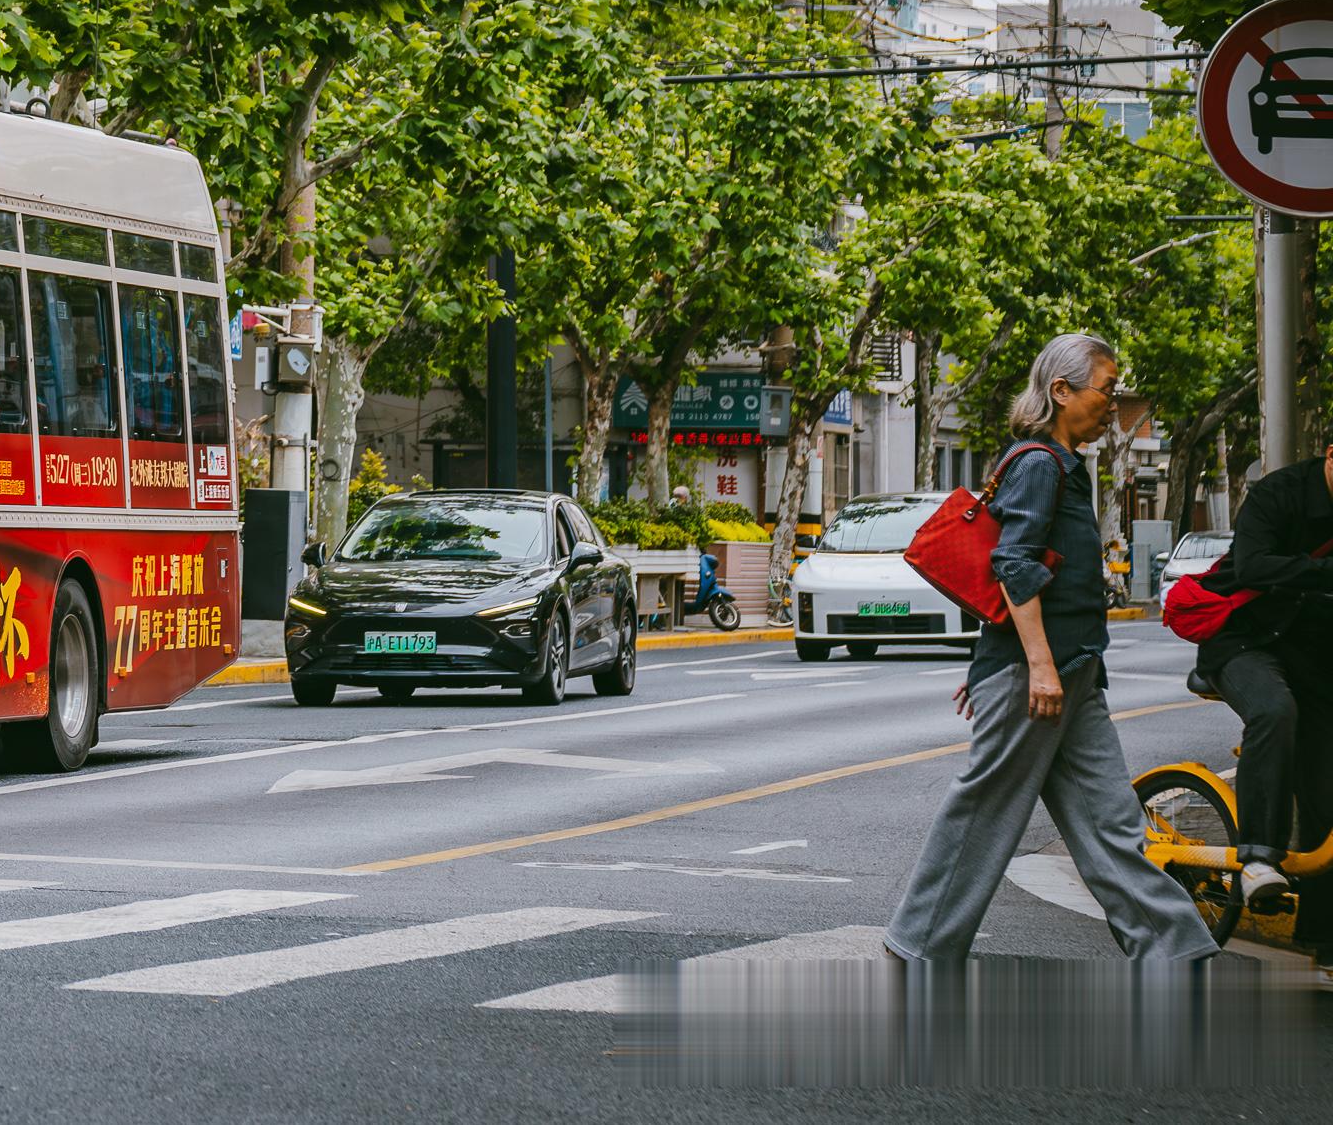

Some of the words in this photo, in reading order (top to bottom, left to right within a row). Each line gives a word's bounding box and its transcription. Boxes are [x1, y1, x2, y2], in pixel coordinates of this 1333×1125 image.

[132, 554, 204, 597] 庆祝上海解放
